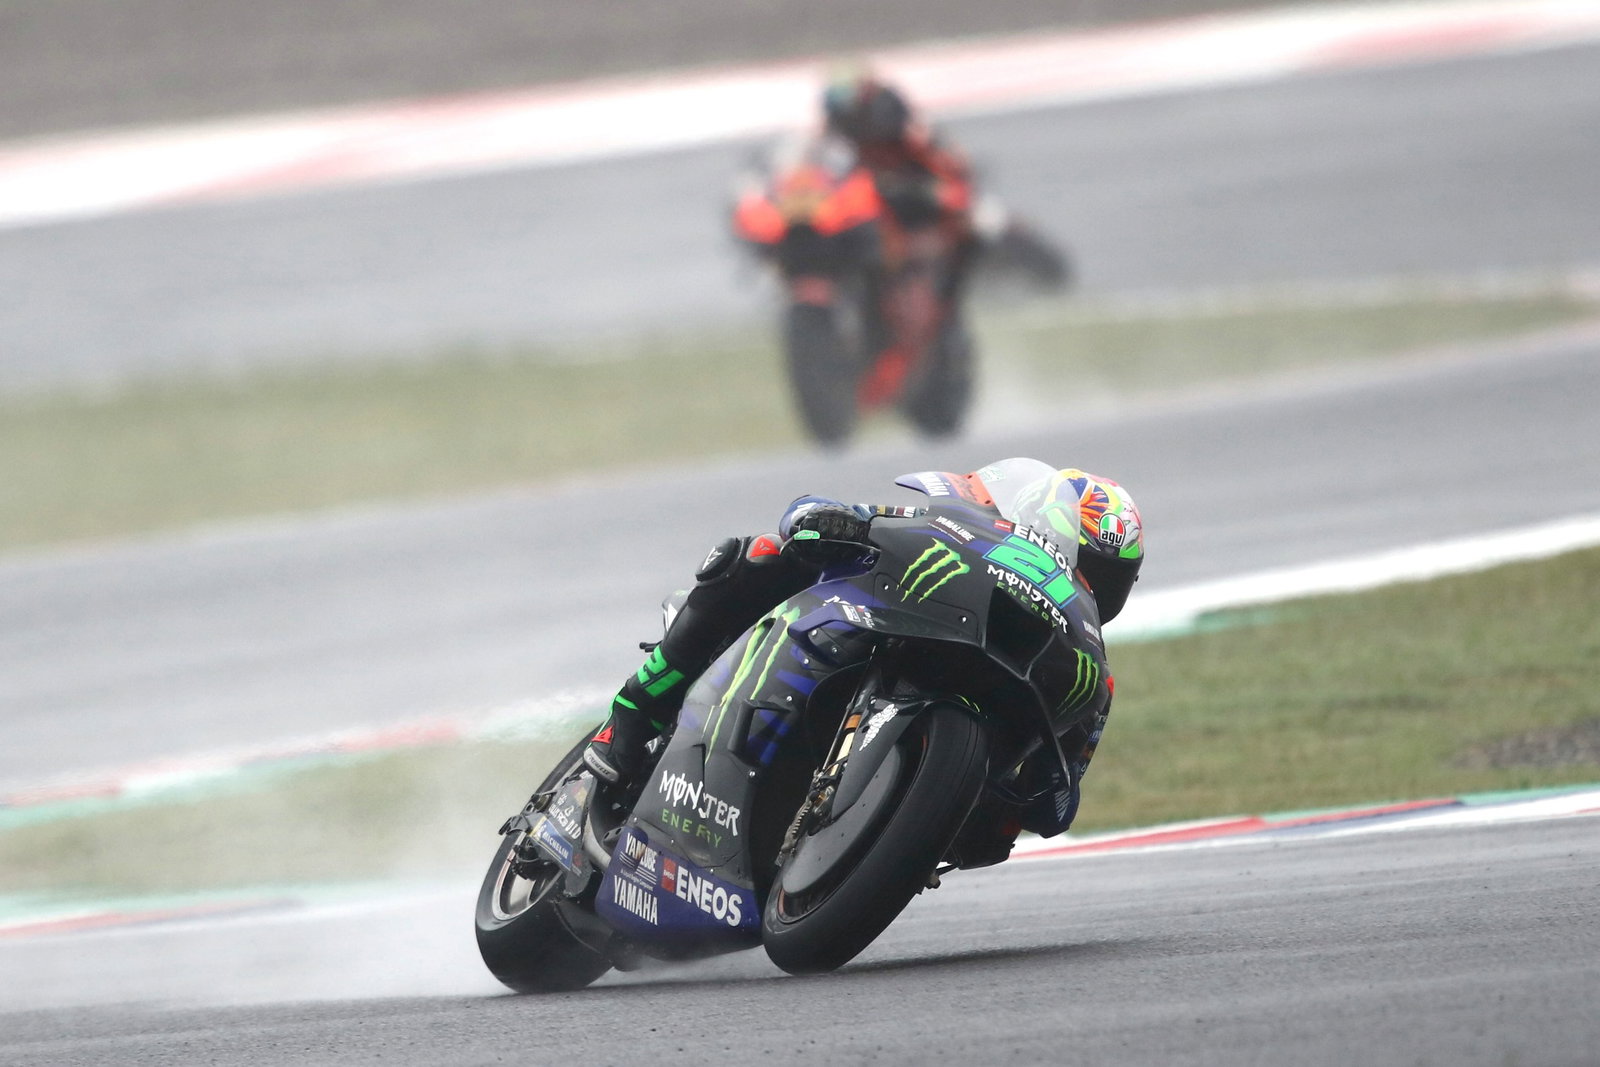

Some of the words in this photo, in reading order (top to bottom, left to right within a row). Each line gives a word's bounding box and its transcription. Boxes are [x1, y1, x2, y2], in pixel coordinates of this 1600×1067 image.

[935, 515, 976, 542] YAMALUBE
[1013, 524, 1073, 581] ENEOS
[982, 533, 1079, 609] 21
[987, 564, 1068, 633] MONSTER
[996, 581, 1057, 628] ENERGY
[541, 832, 569, 859] MICHELIN
[625, 832, 658, 872] YAMUBE
[614, 874, 658, 926] YAMAHA
[675, 865, 742, 927] ENEOS
